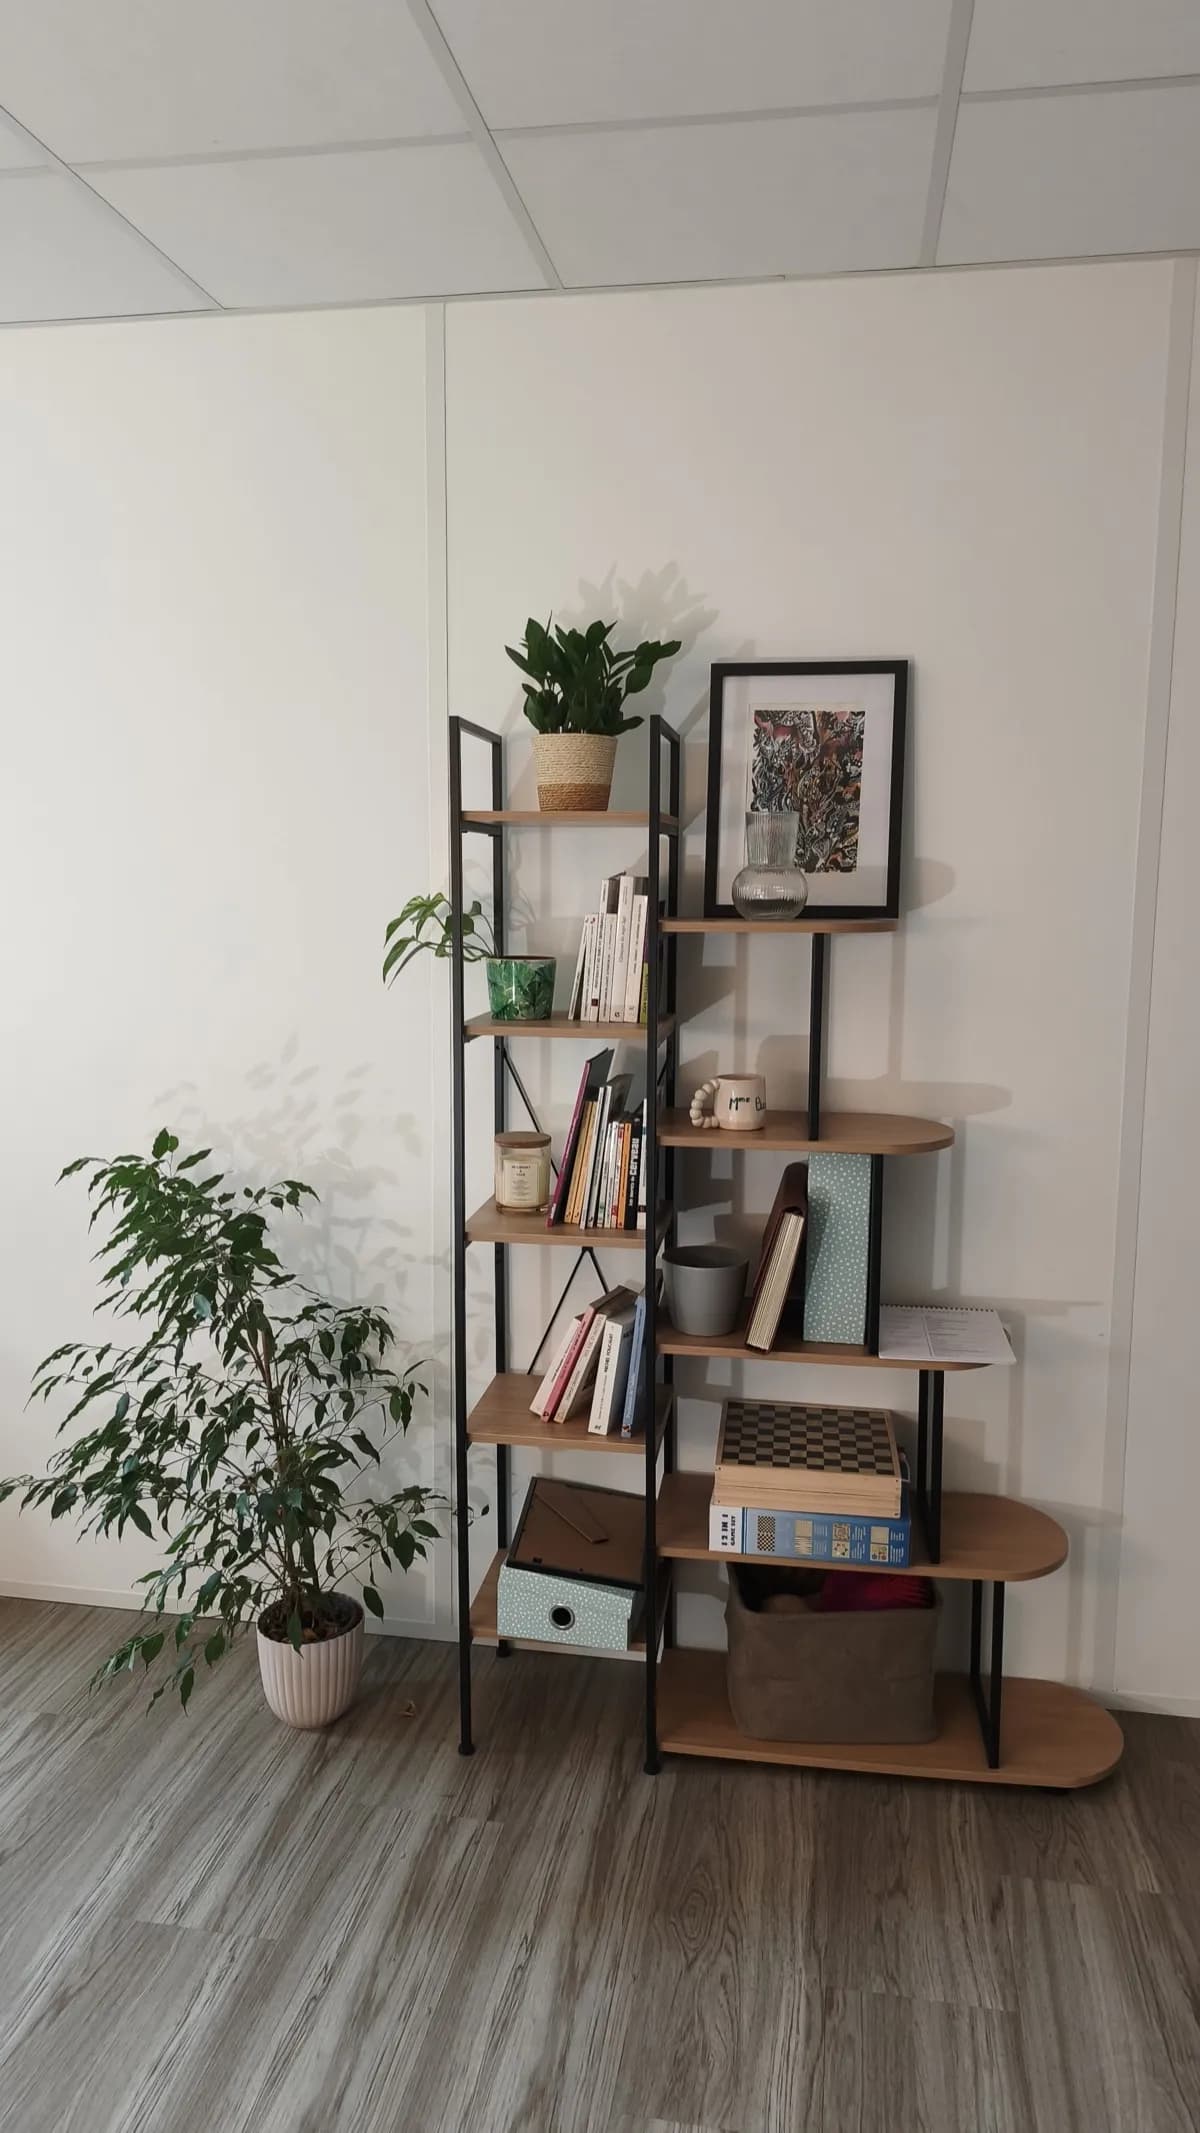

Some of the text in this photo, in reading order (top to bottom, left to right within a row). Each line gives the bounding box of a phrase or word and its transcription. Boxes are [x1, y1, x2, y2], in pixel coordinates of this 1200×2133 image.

[629, 1137, 640, 1176] cerveau
[721, 1521, 729, 1532] IN
[721, 1535, 728, 1546] 12
